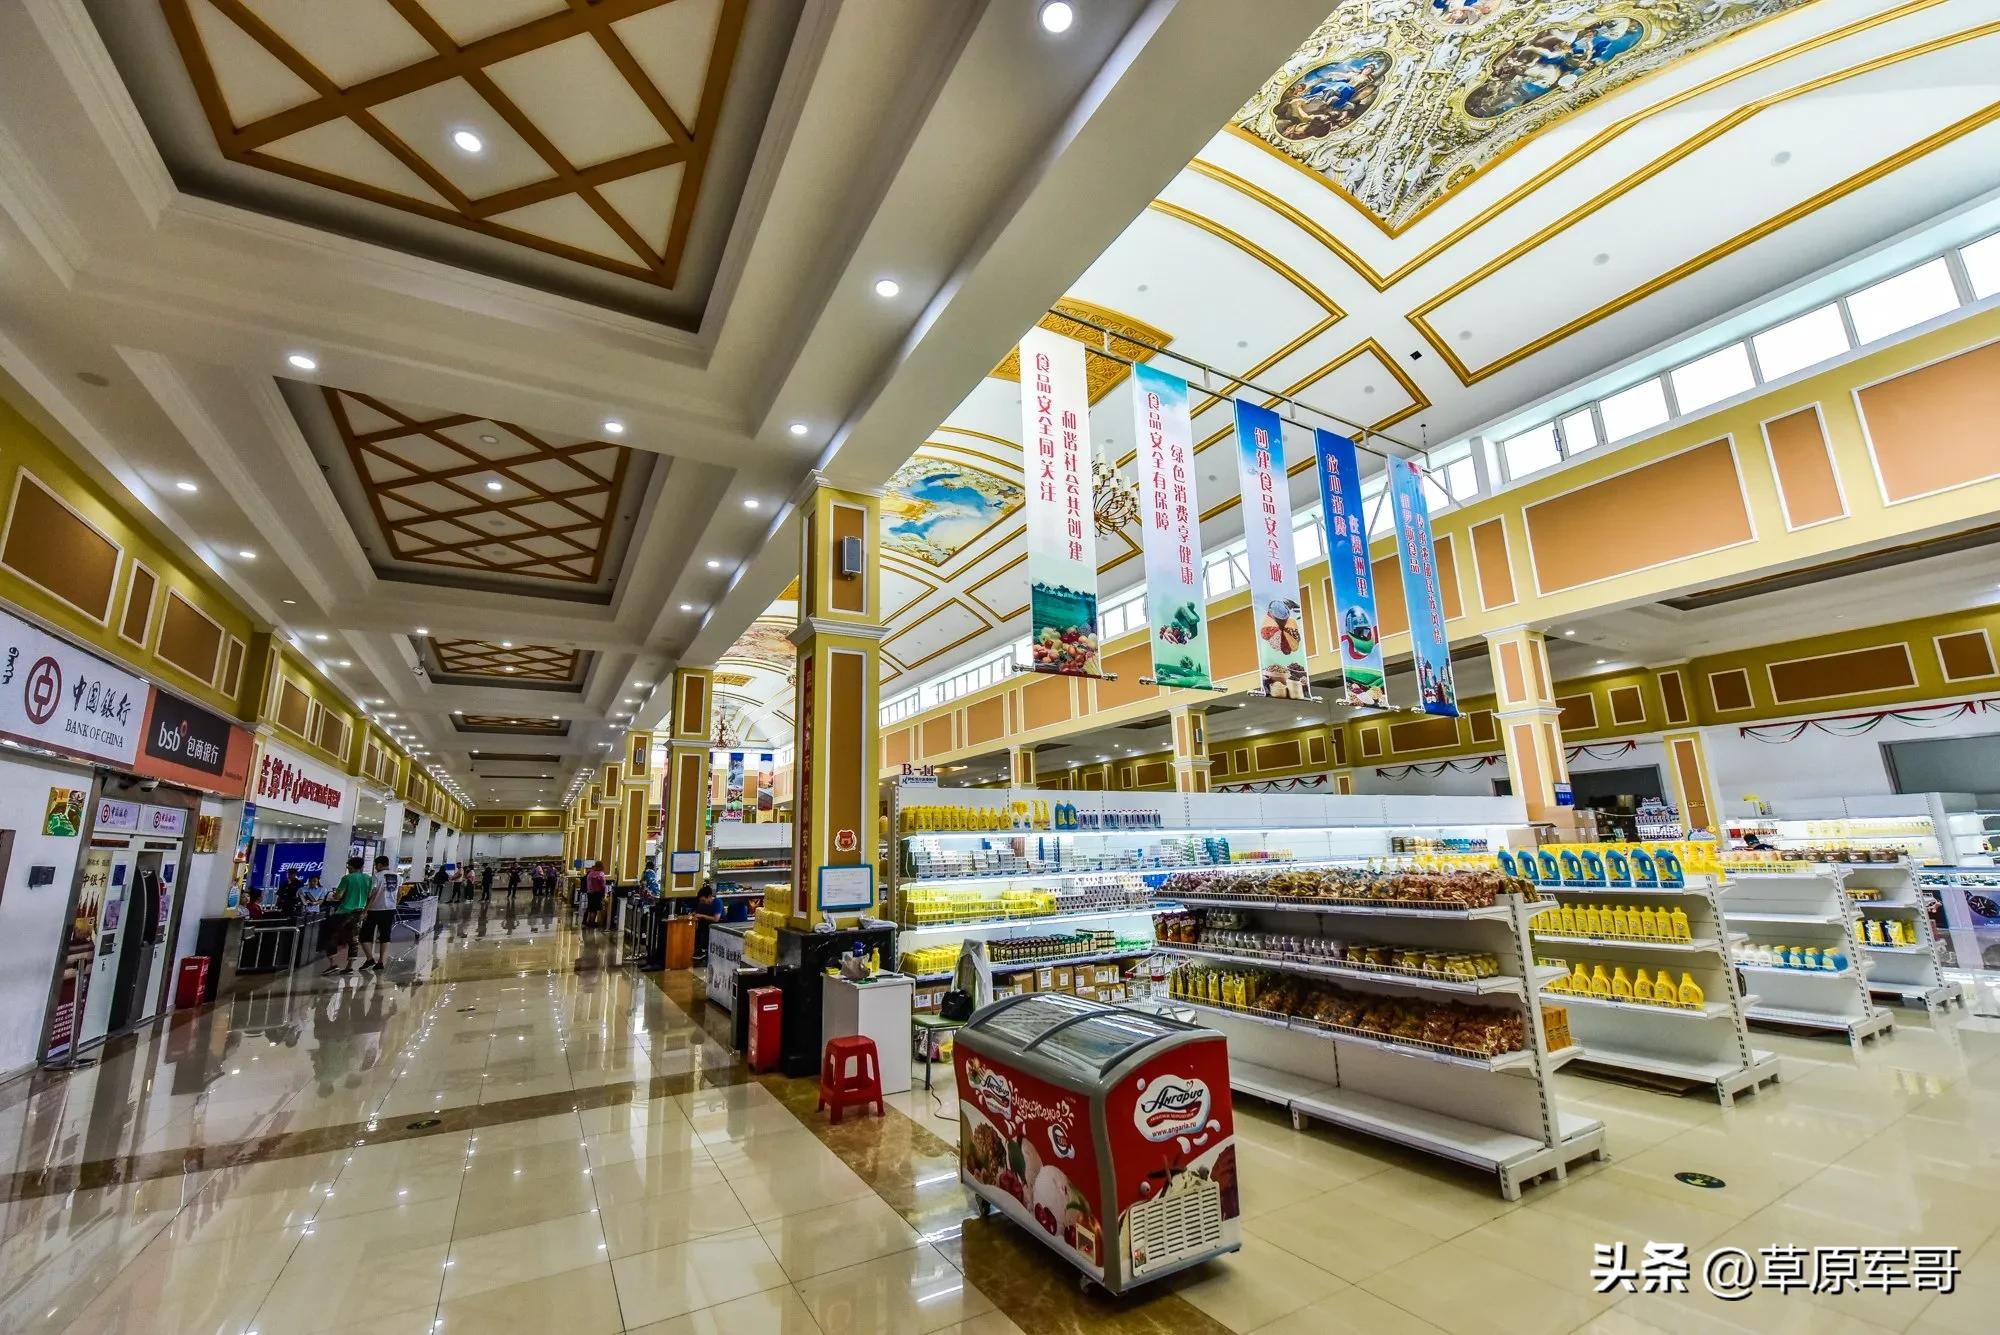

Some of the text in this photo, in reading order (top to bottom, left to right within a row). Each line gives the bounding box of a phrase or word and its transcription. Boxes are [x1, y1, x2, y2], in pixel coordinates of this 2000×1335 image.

[1035, 353, 1056, 502] 食品安全同关注
[1148, 393, 1170, 531] 食品安全有保障
[1062, 410, 1083, 562] 和谐社会共创建
[1170, 444, 1194, 585] 绿色消费享健康
[1254, 428, 1283, 584] 创建食品安全城
[1326, 454, 1348, 537] 放心消费
[66, 719, 124, 748] BANK OF CHINA
[158, 721, 219, 765] bsb 包商银行
[902, 763, 935, 777] B-11
[1152, 1121, 1197, 1137] www.angaria.ru
